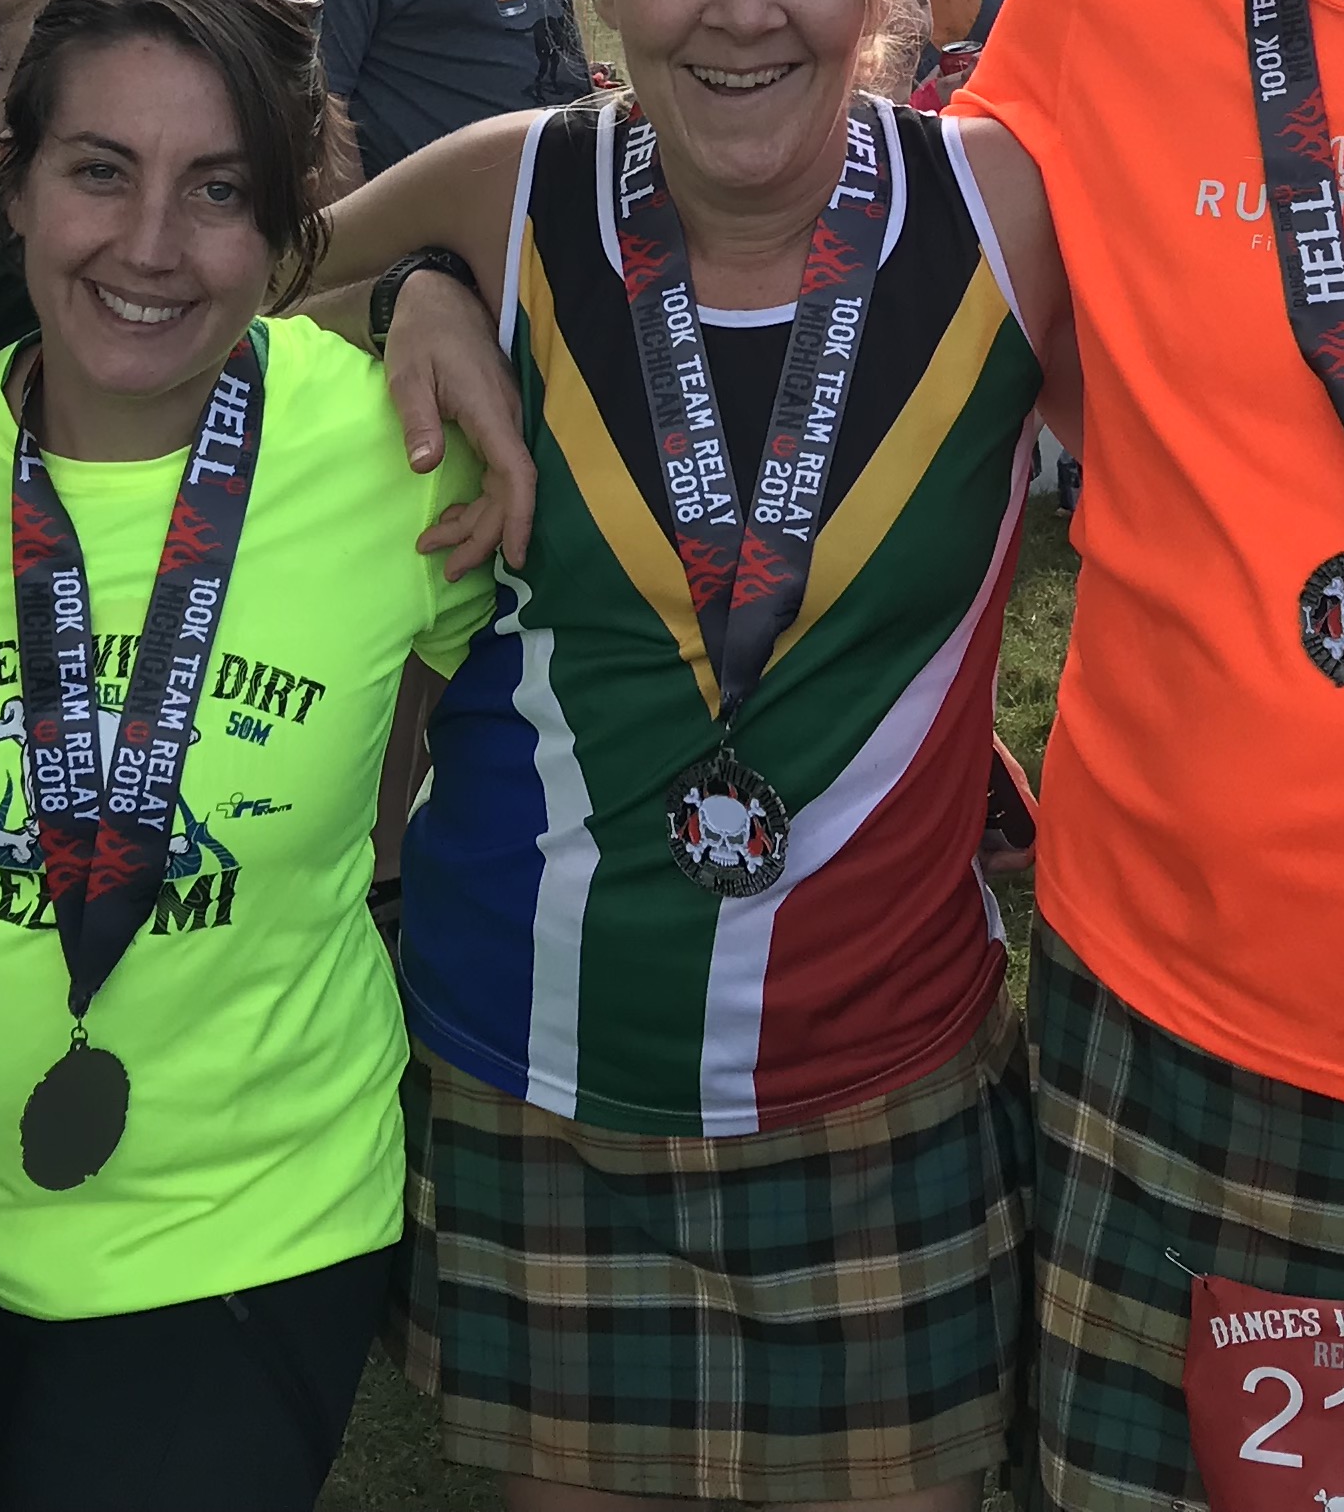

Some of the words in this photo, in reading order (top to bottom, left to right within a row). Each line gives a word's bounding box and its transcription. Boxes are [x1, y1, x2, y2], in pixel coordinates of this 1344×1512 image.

[1255, 35, 1287, 101] 100K
[620, 122, 657, 219] HELL
[661, 282, 697, 347] 100K
[823, 297, 863, 360] 100K
[676, 354, 715, 431] TEAM
[803, 370, 844, 444] TEAM
[187, 371, 251, 485] HELL
[666, 460, 703, 524] 2018
[693, 439, 737, 527] RELAY
[755, 459, 791, 525] 2018
[782, 452, 826, 542] RELAY
[52, 567, 83, 632] 100K
[180, 577, 221, 641] 100K
[57, 642, 90, 722] TEAM
[156, 654, 201, 731] TEAM
[210, 652, 326, 725] DIRT
[225, 710, 274, 747] 50M
[35, 747, 68, 812] 2018
[64, 732, 101, 822] RELAY
[108, 747, 146, 813] 2018
[138, 738, 180, 832] RELAY
[150, 866, 242, 935] MI
[1209, 1308, 1321, 1349] DANCES
